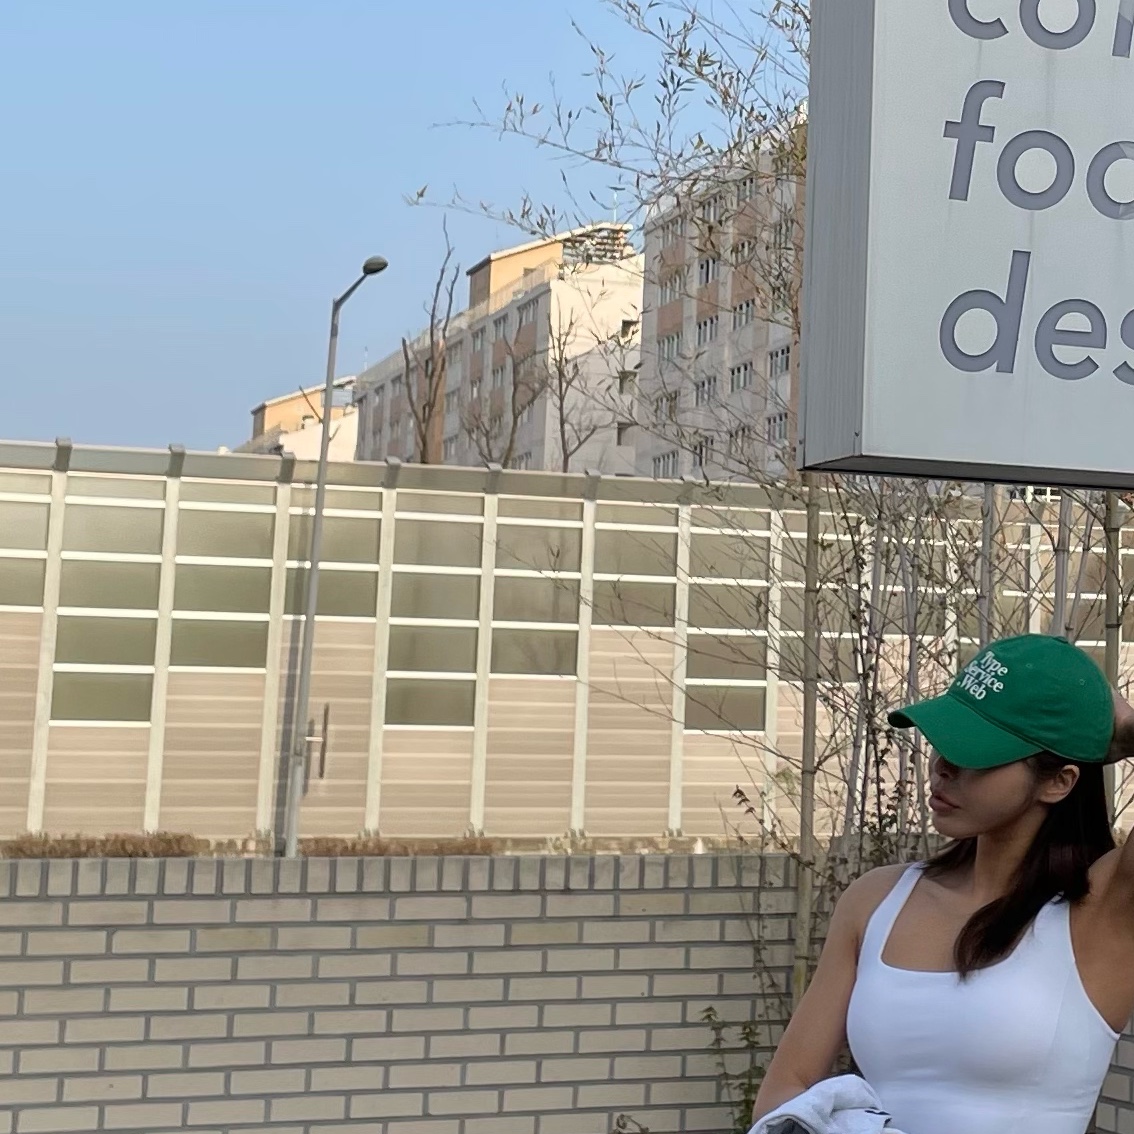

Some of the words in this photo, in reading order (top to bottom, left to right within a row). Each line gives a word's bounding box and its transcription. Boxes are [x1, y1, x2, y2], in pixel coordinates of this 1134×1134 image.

[964, 660, 1004, 692] Service
[979, 651, 1008, 676] Type
[957, 674, 987, 700] .Web
